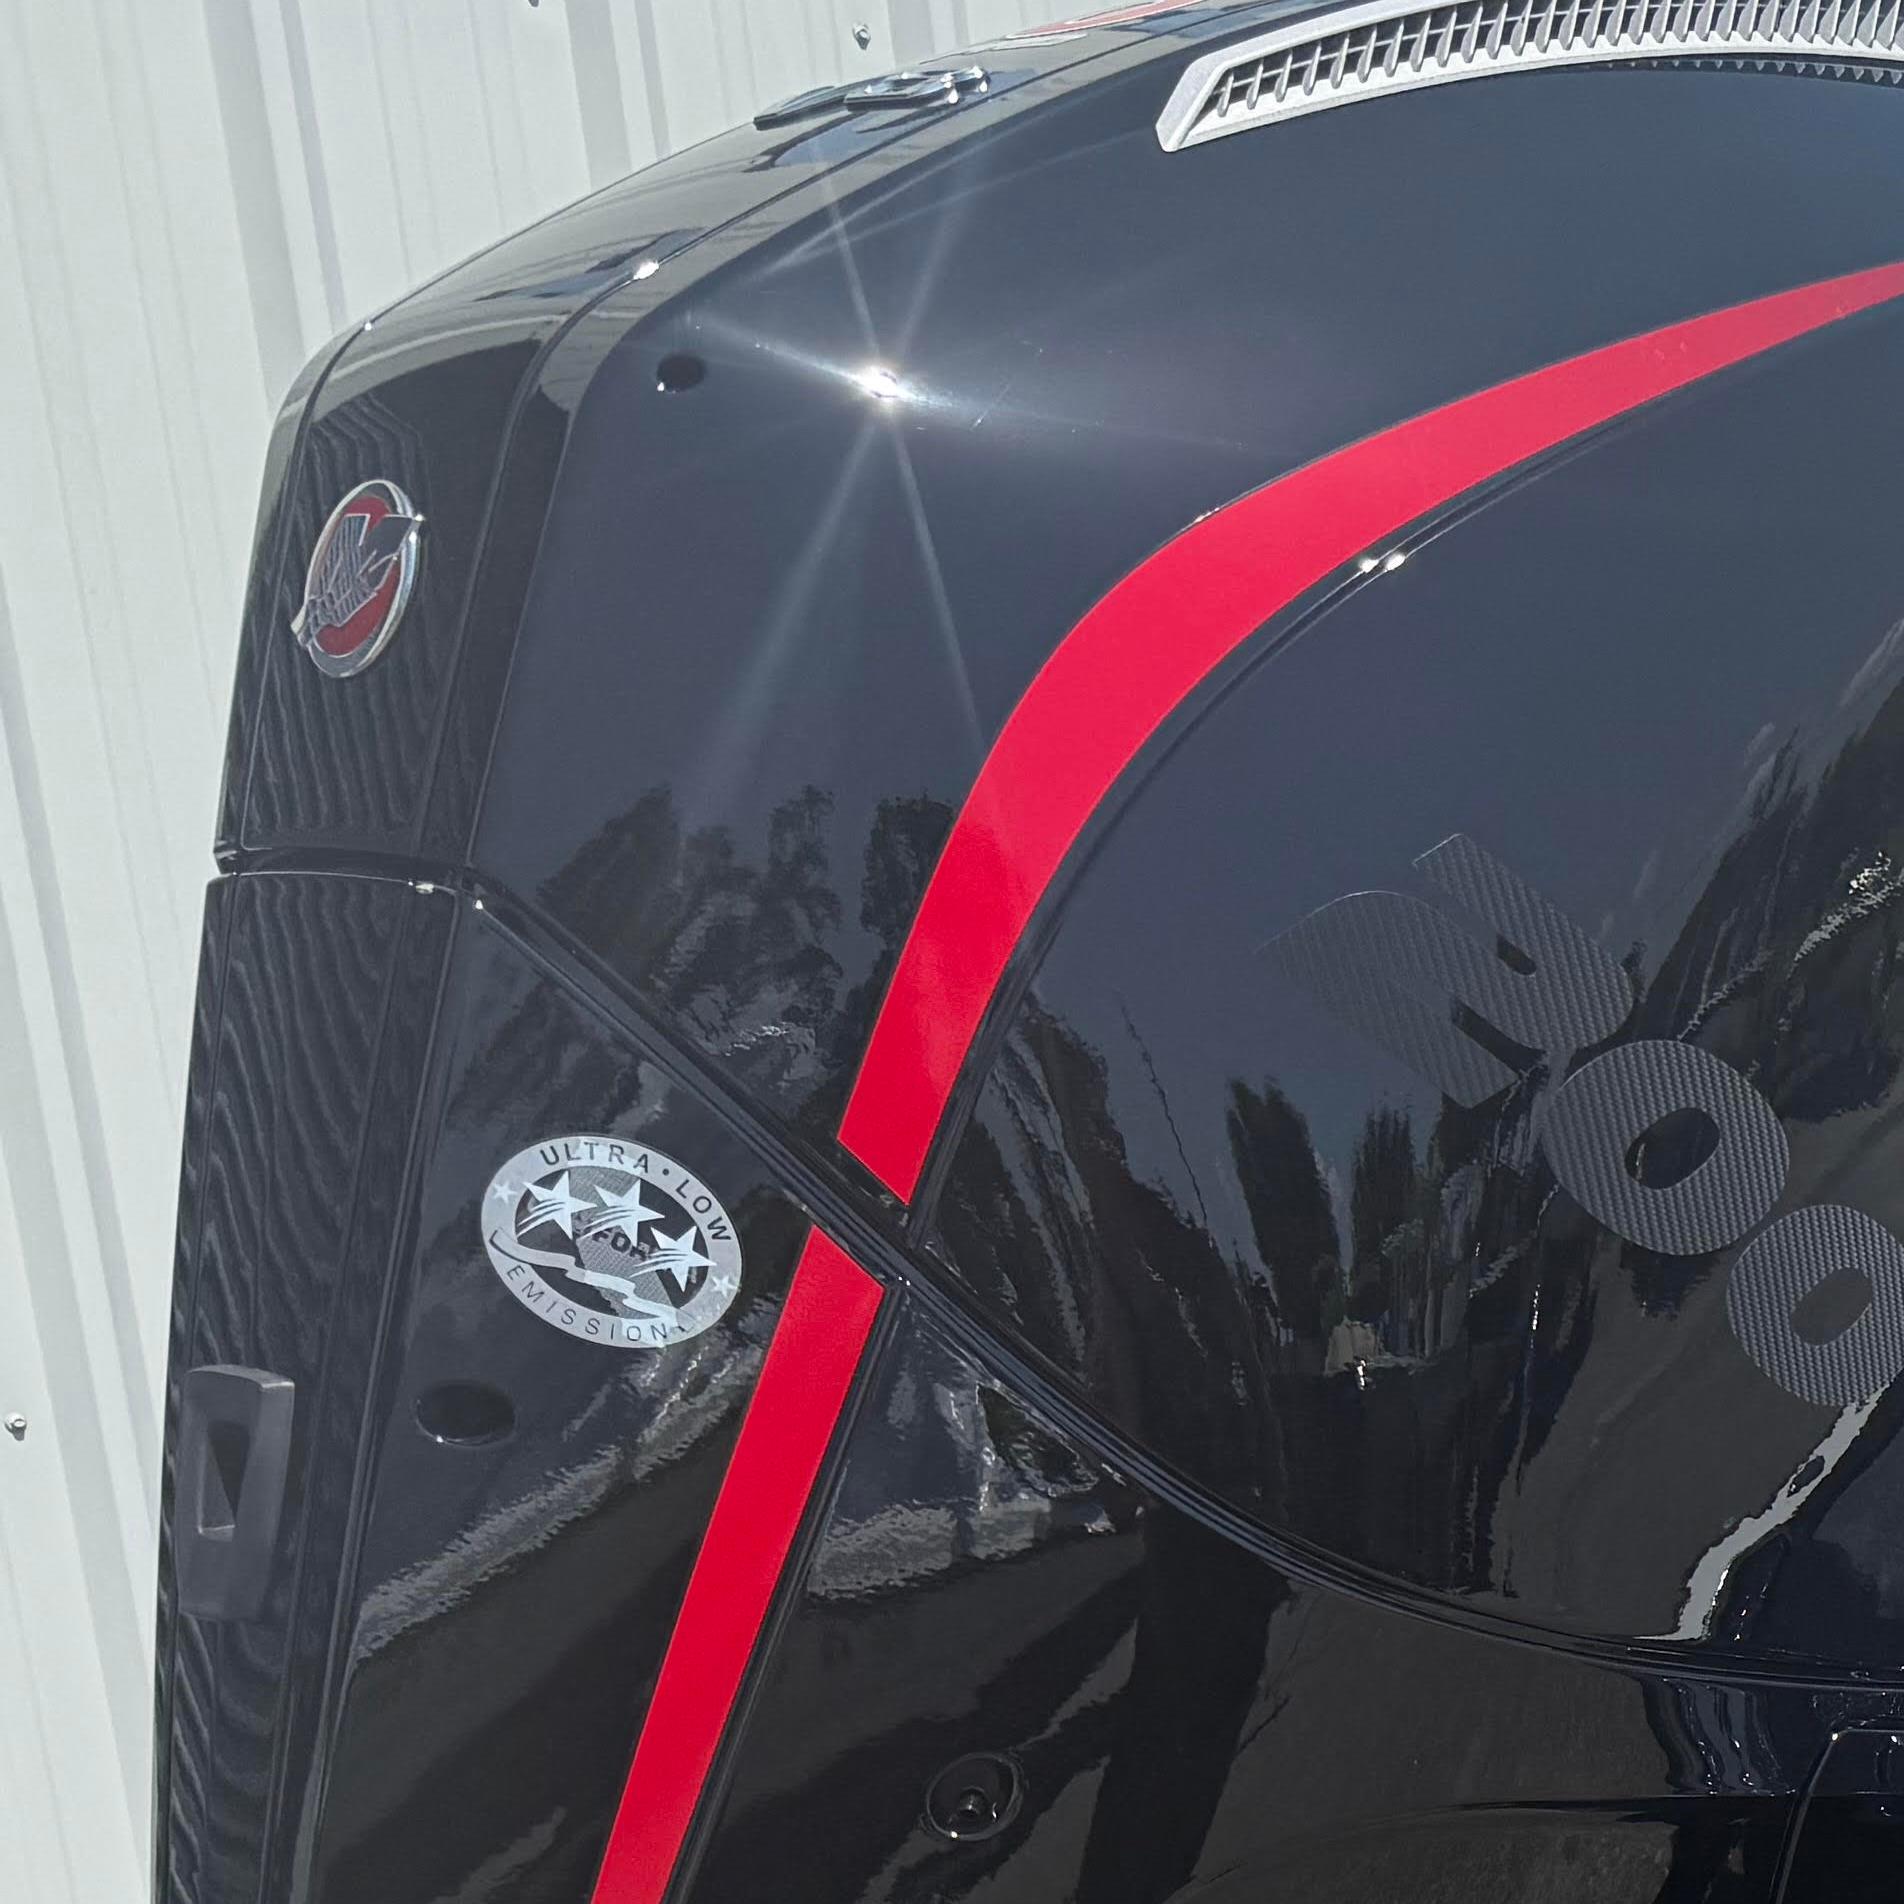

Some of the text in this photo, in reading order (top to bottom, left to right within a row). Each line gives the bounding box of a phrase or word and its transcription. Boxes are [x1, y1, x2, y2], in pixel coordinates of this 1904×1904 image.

[539, 1141, 732, 1242] ULTRA LOW
[506, 1264, 668, 1342] EMISSION
